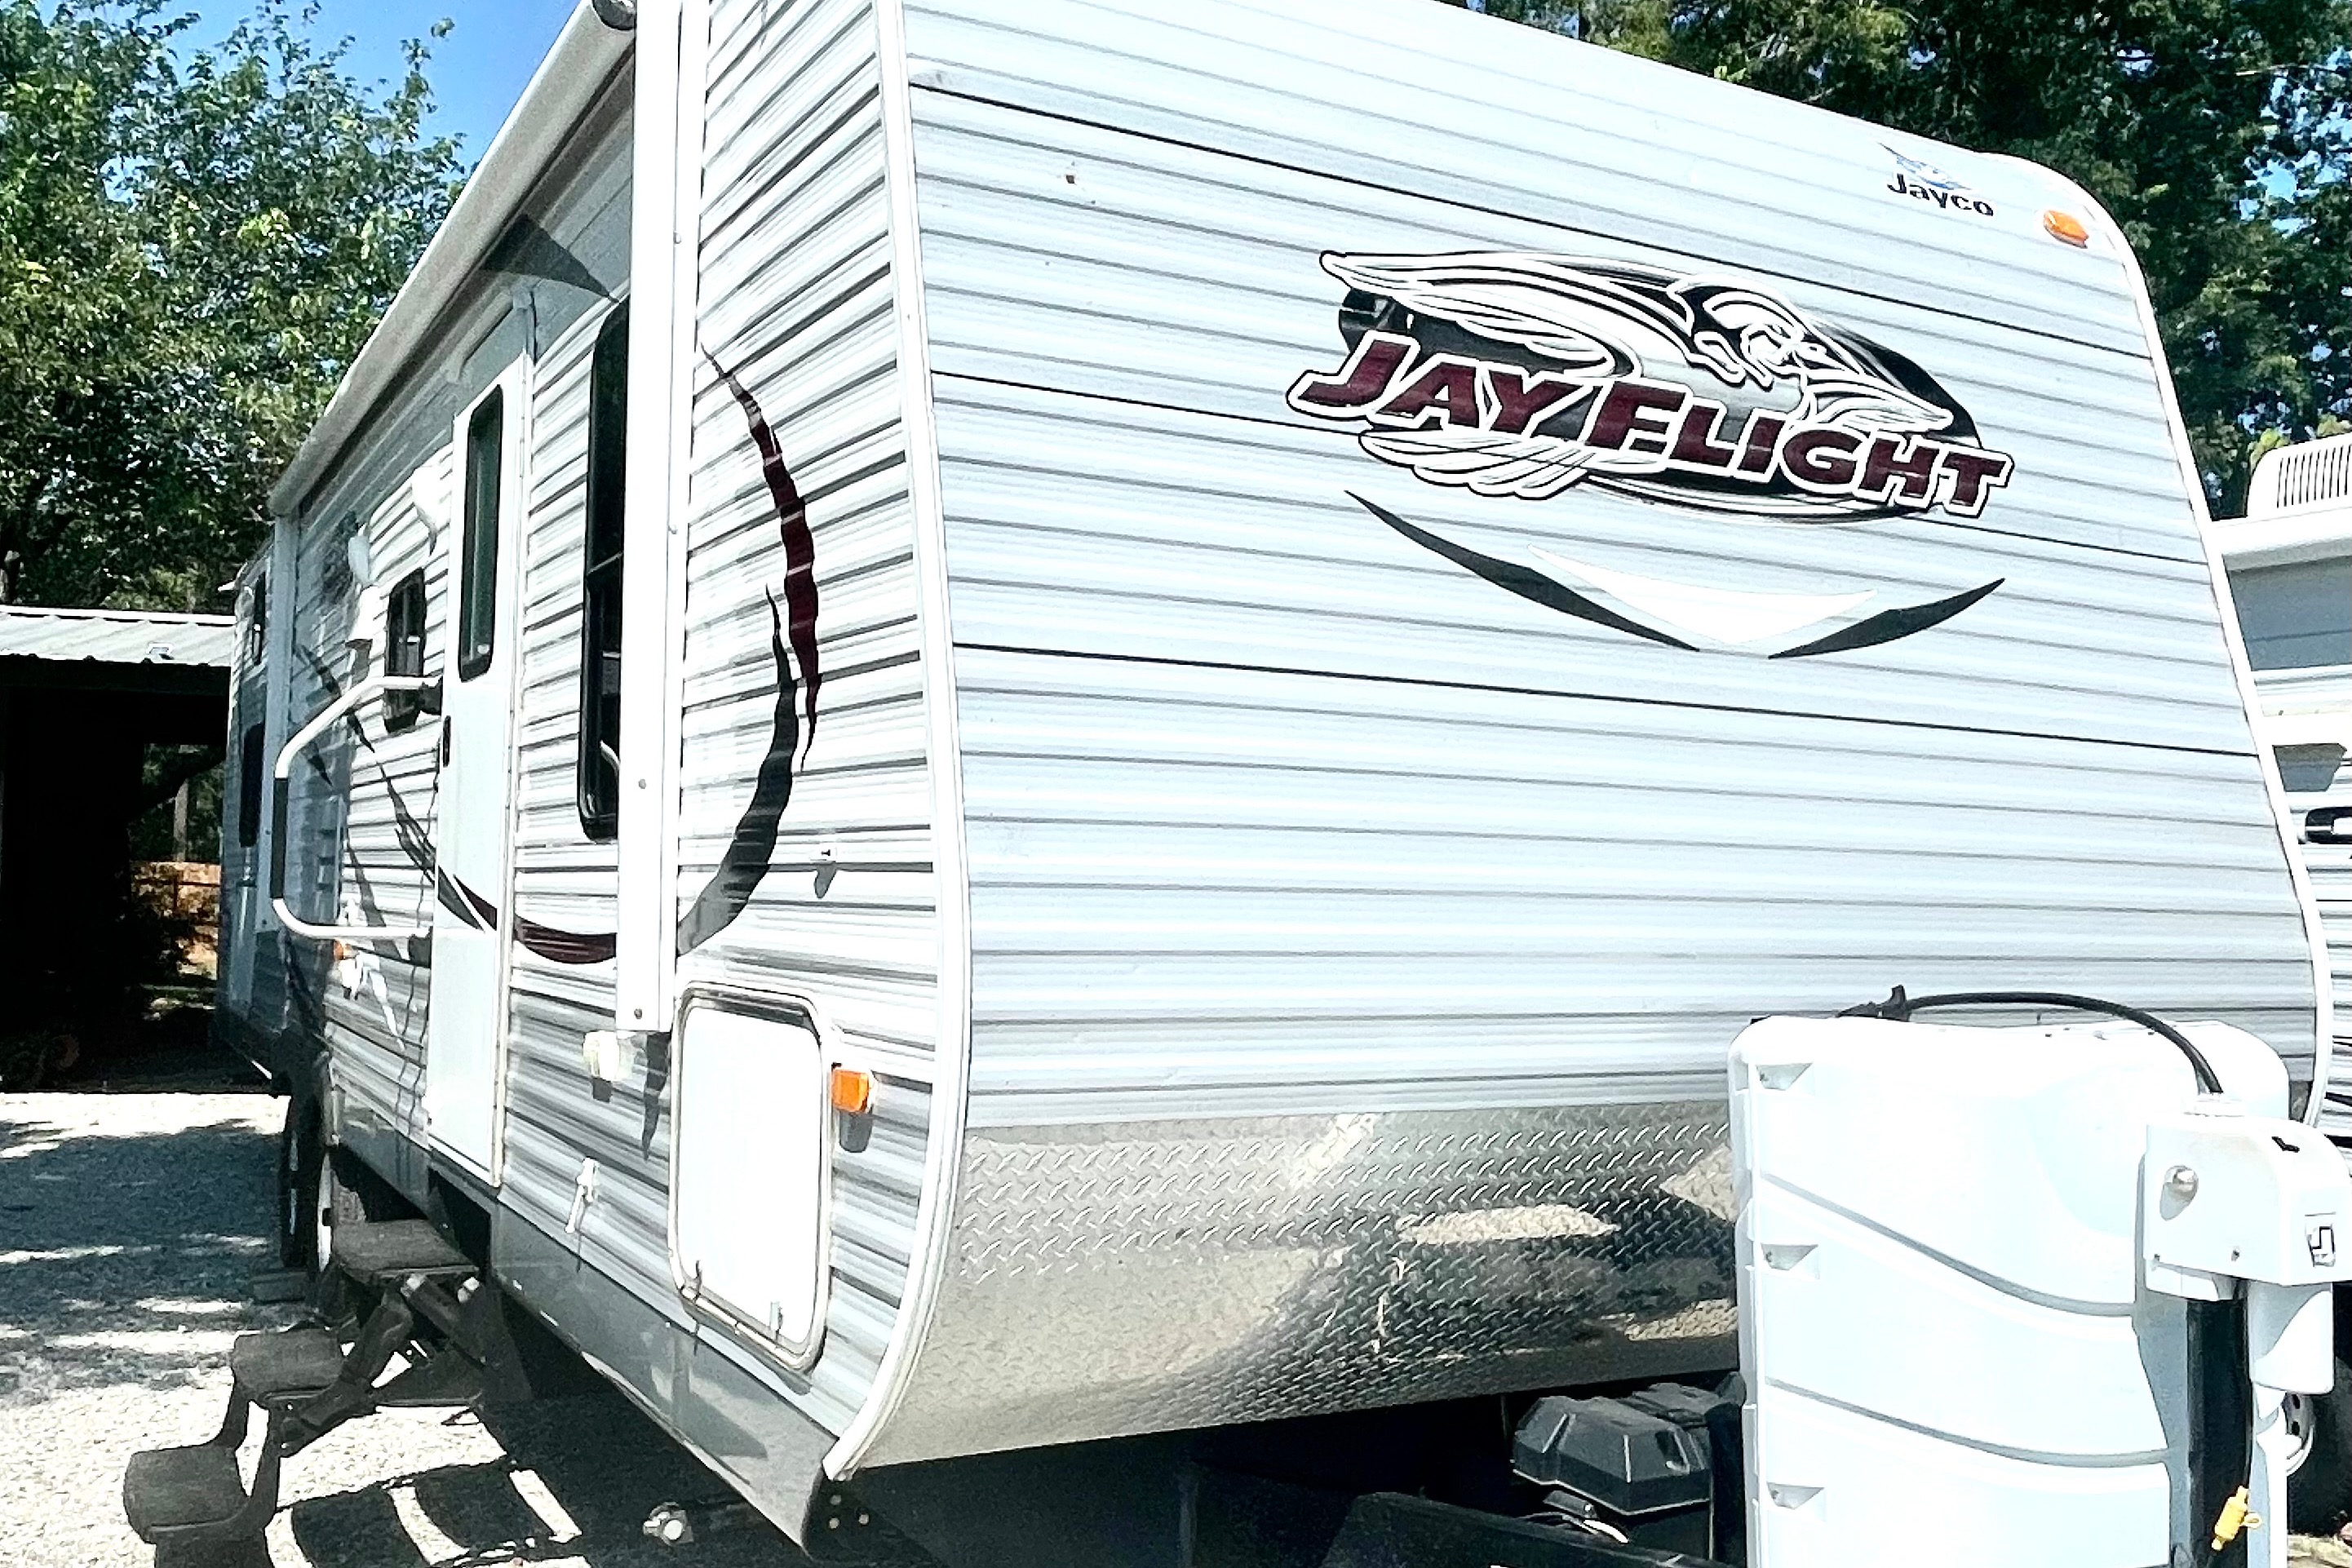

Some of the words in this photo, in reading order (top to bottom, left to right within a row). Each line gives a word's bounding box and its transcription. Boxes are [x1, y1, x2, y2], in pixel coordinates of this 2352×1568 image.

[1886, 172, 1994, 217] Jayco
[1287, 330, 1589, 440] JAY
[1581, 377, 2014, 517] FLIGHT
